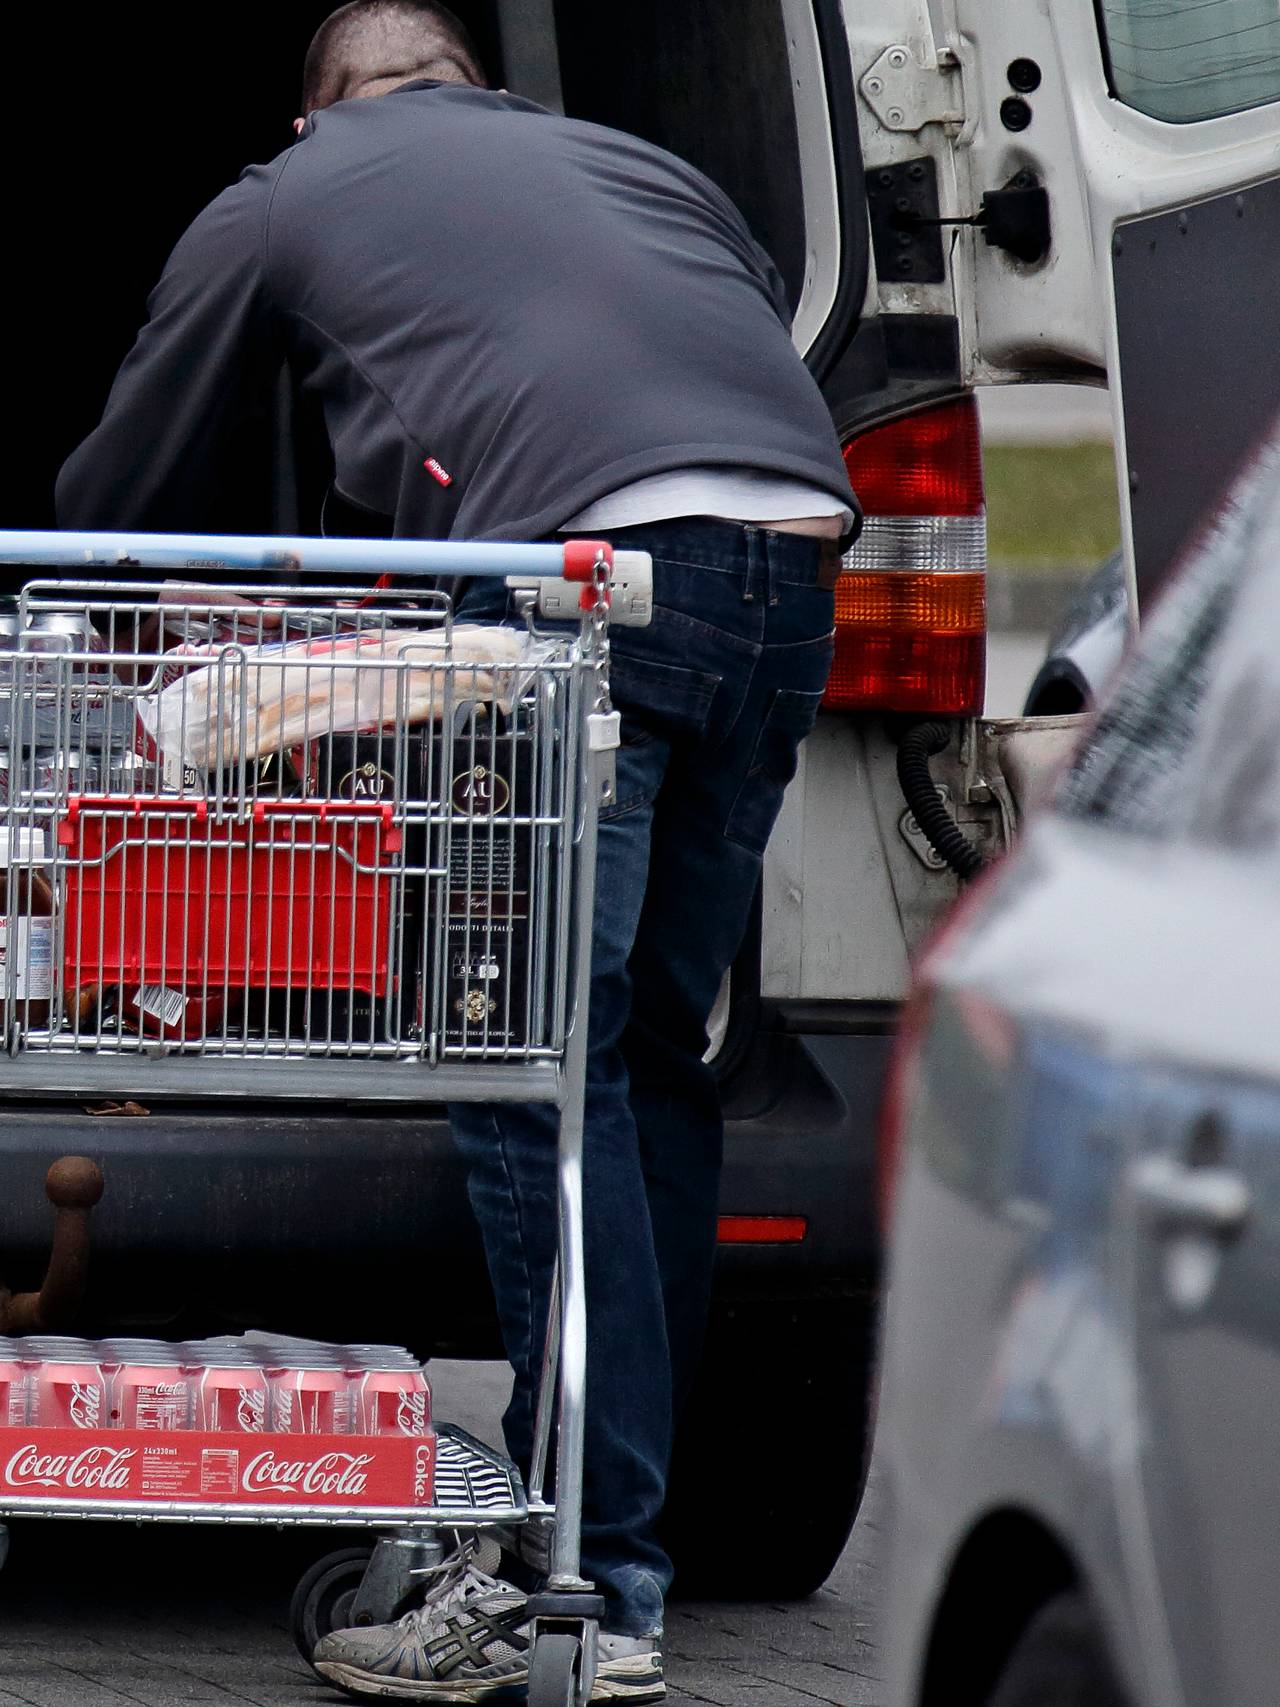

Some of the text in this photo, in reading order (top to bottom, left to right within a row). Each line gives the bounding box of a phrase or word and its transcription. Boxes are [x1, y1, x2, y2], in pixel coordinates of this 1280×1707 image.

[5, 1444, 138, 1490] Coca-Cola
[242, 1451, 375, 1495] Coca-Cola
[414, 1445, 431, 1497] Coke
